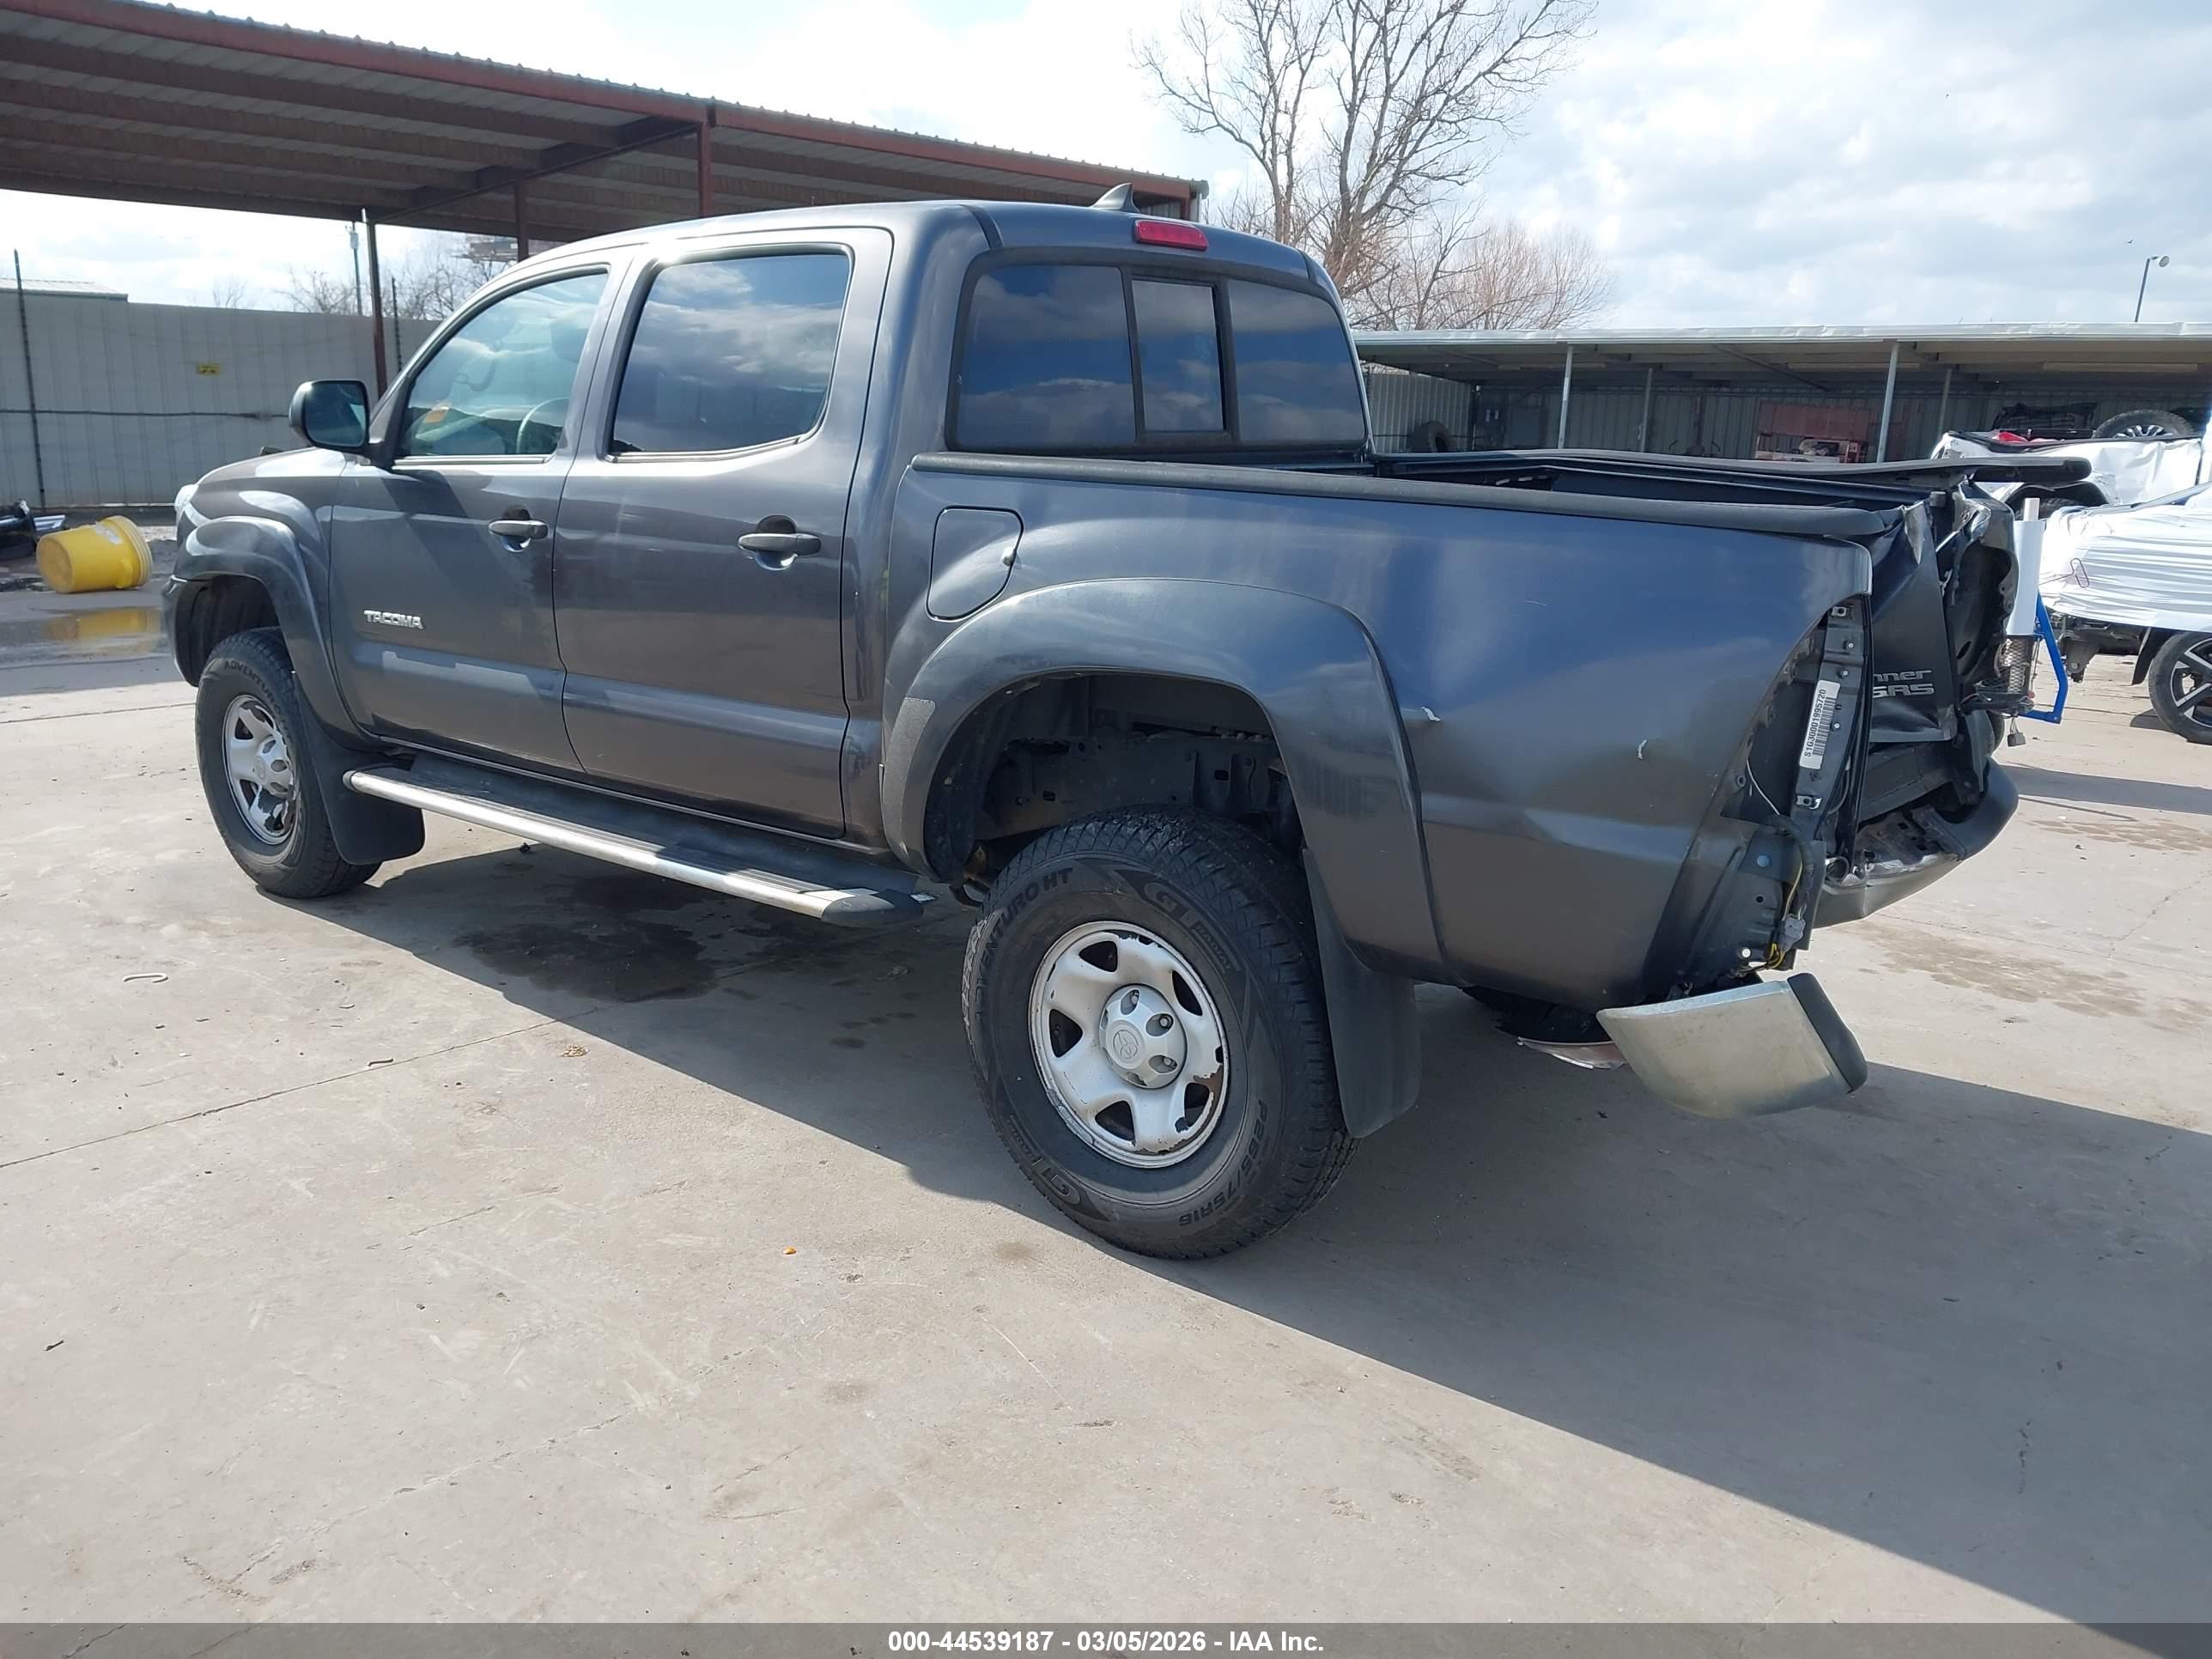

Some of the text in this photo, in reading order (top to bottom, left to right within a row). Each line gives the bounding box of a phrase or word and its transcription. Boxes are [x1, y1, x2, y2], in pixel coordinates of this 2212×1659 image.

[364, 610, 425, 629] TACOMA
[1873, 684, 1934, 698] SR5
[1804, 689, 1826, 757] S1G30001995720
[1043, 867, 1073, 891] HT
[1178, 1099, 1267, 1227] P265/75R16
